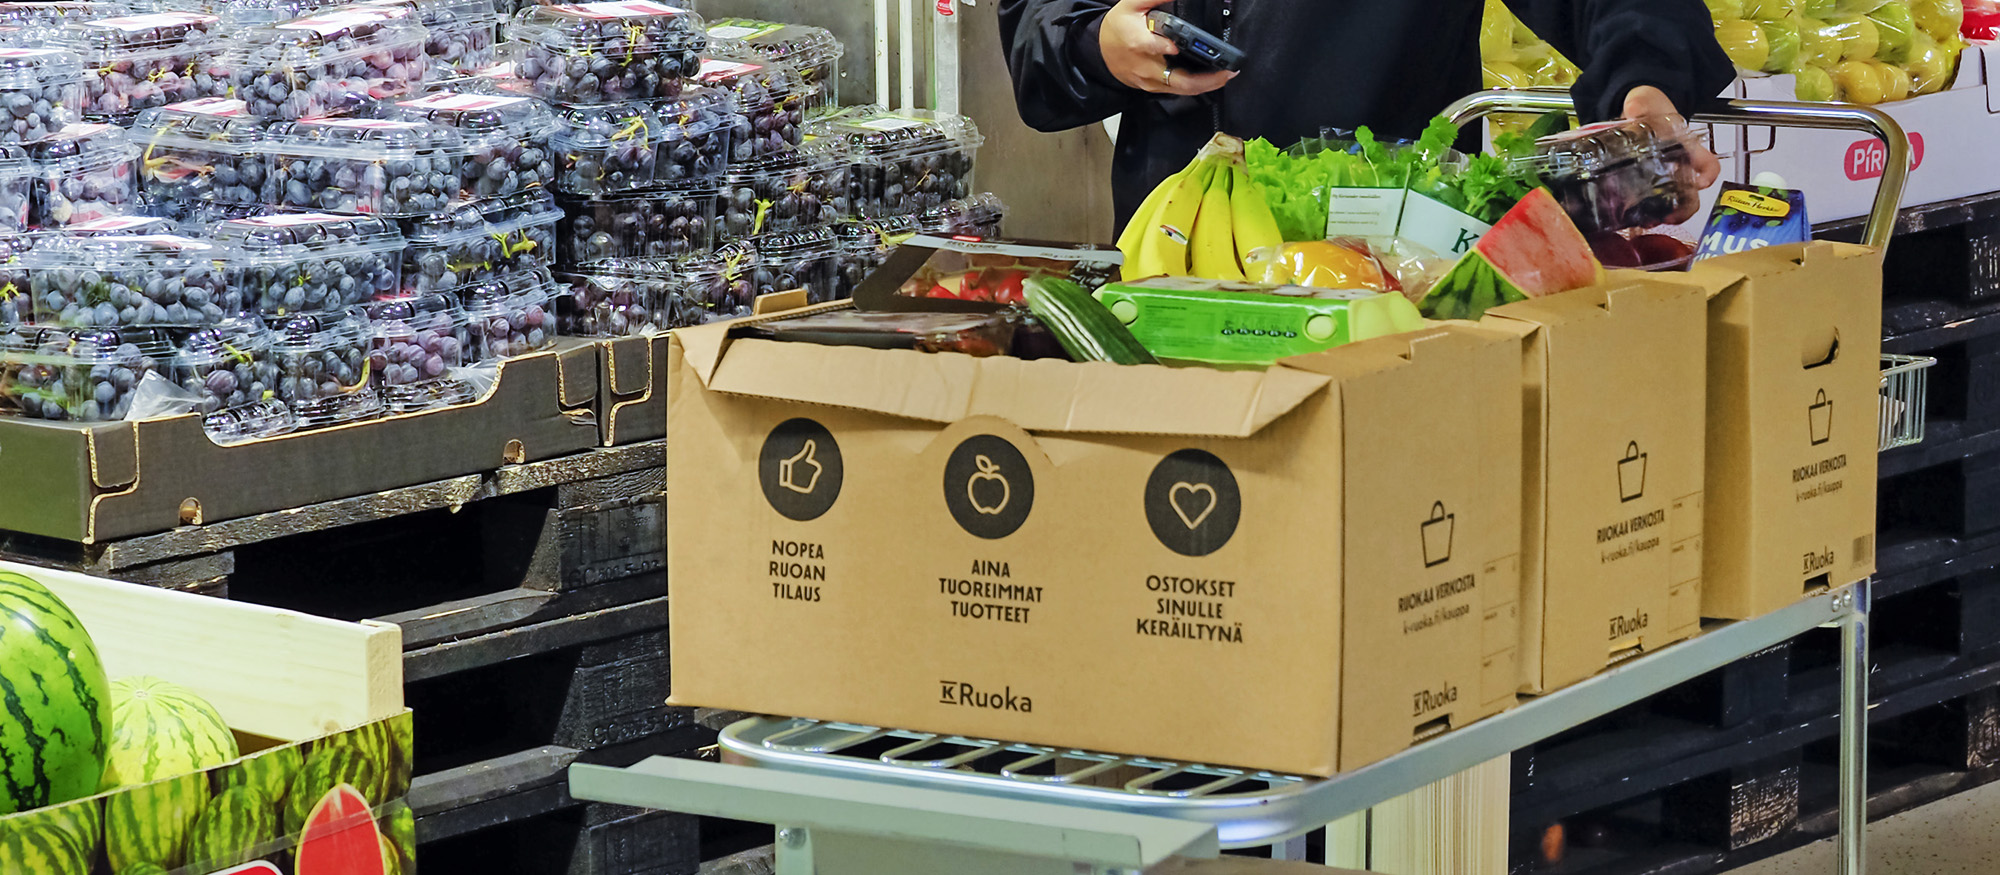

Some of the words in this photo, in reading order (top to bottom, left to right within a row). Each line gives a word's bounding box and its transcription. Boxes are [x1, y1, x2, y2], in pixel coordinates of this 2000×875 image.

[1792, 463, 1818, 484] RUOKAA
[1819, 454, 1847, 476] VERKOSTA
[1596, 520, 1629, 545] RUOKAA
[1630, 508, 1665, 534] VERKOSTA
[772, 539, 824, 559] NOPEA
[768, 561, 826, 581] RUOAN
[971, 559, 1011, 578] AINA
[772, 583, 820, 602] TILAUS
[938, 578, 1043, 603] TUOREIMMAT
[1145, 574, 1236, 598] OSTOKSET
[1398, 587, 1434, 613] RUOKAA
[1435, 573, 1476, 601] VERKOSTA
[950, 601, 1030, 624] TUOTTEET
[1156, 597, 1223, 619] SINULLE
[1403, 604, 1470, 635] k-ruoka.fi/kauppa
[1136, 617, 1243, 643] KERÄILTYNÄ
